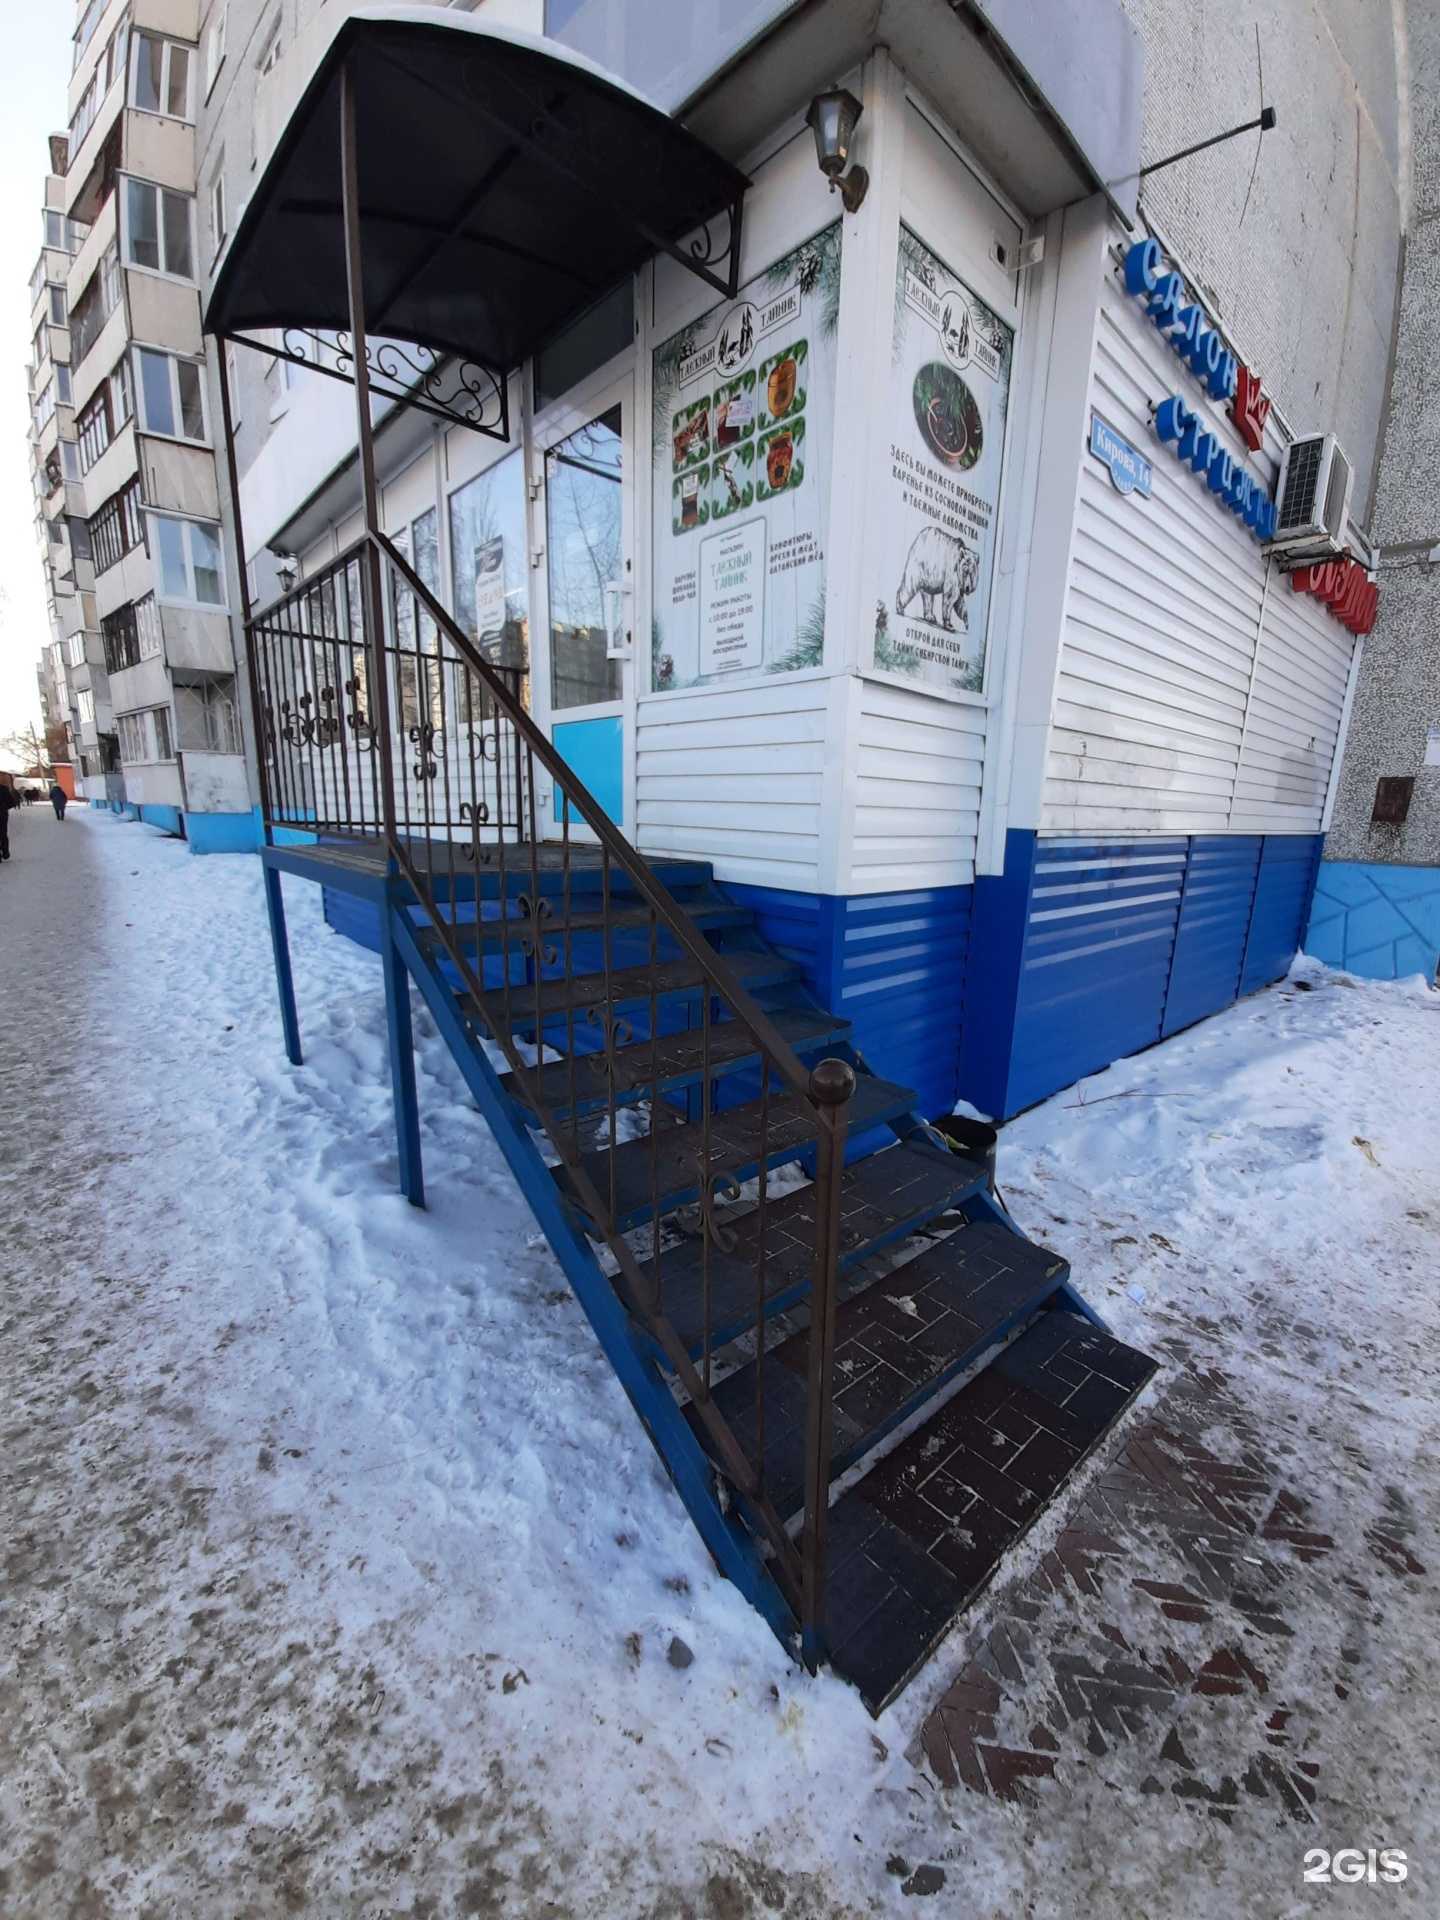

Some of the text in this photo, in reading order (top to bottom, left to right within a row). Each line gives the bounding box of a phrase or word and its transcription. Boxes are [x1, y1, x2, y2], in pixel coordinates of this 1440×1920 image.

[890, 444, 992, 514] ЗДЕСЬ ВЫ МОЖЕТЕ ПРИОБРЕСТИ
[892, 465, 988, 529] ВАРЕНЬЕ ИЗ СОСНОВОЙ ШИШКИ
[942, 514, 978, 540] ЛАКОМСТВА
[893, 640, 913, 656] ТАЙНУ
[915, 646, 949, 666] СИБИРСКОЙ
[906, 628, 961, 654] ОТКРОЙ ДЛЯ СЕБЯ
